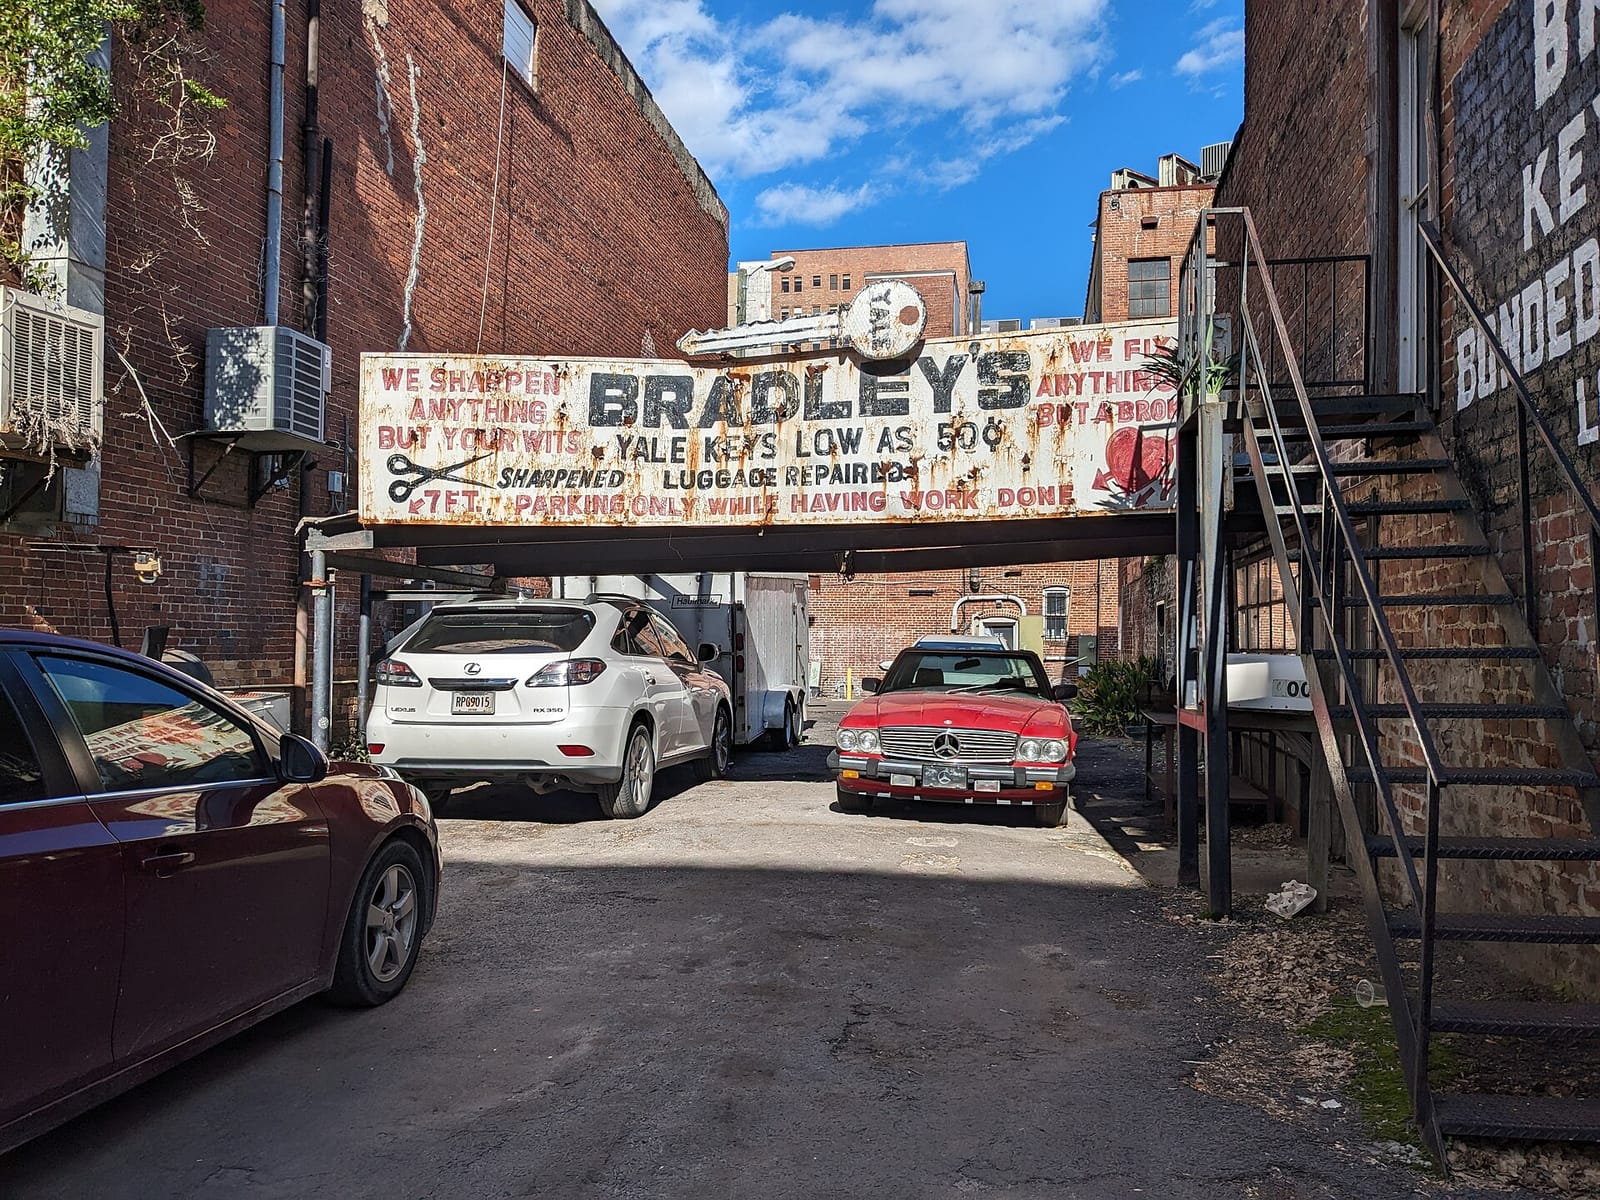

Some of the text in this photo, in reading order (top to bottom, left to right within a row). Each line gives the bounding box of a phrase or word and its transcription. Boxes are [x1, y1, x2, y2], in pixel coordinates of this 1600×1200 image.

[1523, 100, 1600, 252] KE
[1457, 238, 1600, 412] BONDED
[1069, 336, 1172, 364] WE FIX
[381, 367, 561, 395] WE SHARPEN
[587, 341, 1031, 430] BRADLEY'S
[409, 398, 548, 424] ANYTHING
[1037, 401, 1090, 428] BUT
[1096, 401, 1112, 424] A
[378, 425, 583, 454] BUT YOUR WITS
[615, 416, 1002, 464] YALE KEYS LOW AS 50¢
[497, 461, 904, 490] SHARPENED LUGGAGE REPAIRED
[514, 494, 625, 516] PARKING
[631, 494, 698, 517] ONLY
[708, 494, 779, 515] WHILE
[791, 491, 887, 513] HAVING
[900, 488, 980, 511] WORK
[998, 484, 1075, 508] DONE
[456, 696, 490, 708] RPG9015
